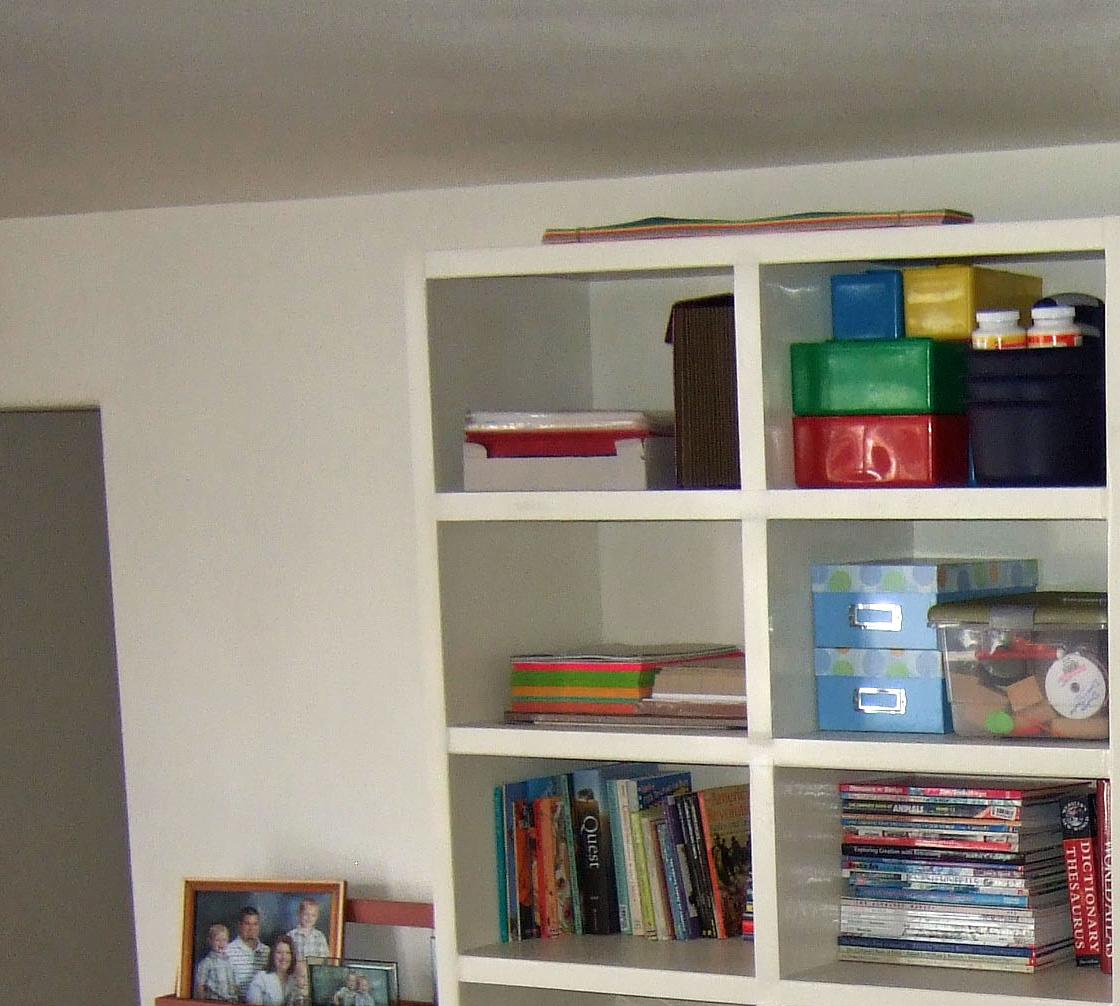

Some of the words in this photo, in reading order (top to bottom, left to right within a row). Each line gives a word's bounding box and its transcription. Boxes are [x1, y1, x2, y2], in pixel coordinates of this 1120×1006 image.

[580, 815, 599, 869] Quest
[1064, 847, 1085, 950] THESAURUS
[1080, 841, 1100, 953] DICTIONARY
